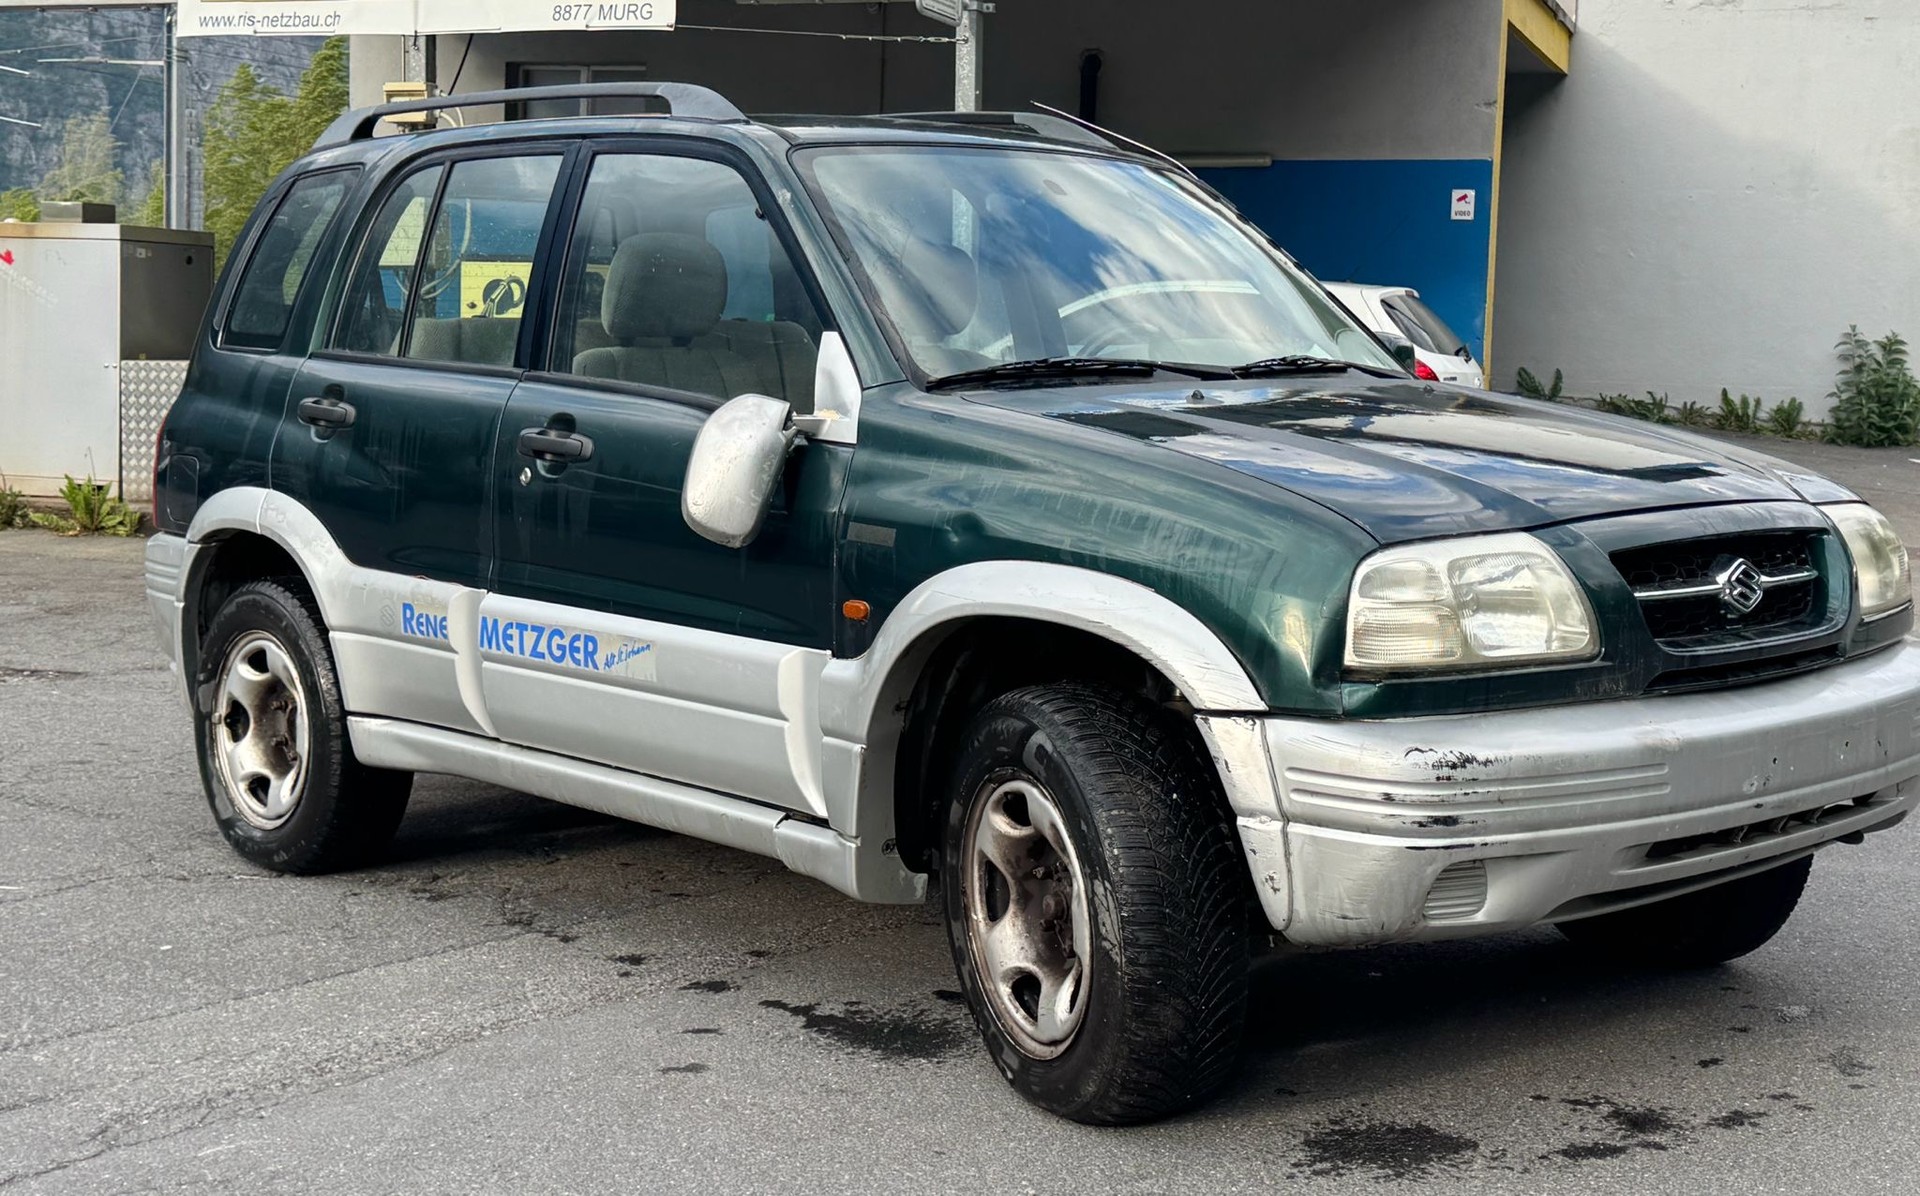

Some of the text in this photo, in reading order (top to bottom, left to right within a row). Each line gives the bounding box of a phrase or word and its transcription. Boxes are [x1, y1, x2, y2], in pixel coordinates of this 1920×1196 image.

[199, 11, 341, 28] www.ris-netzbau.ch
[552, 3, 653, 21] 8877 MURG
[479, 616, 599, 670] METZGER
